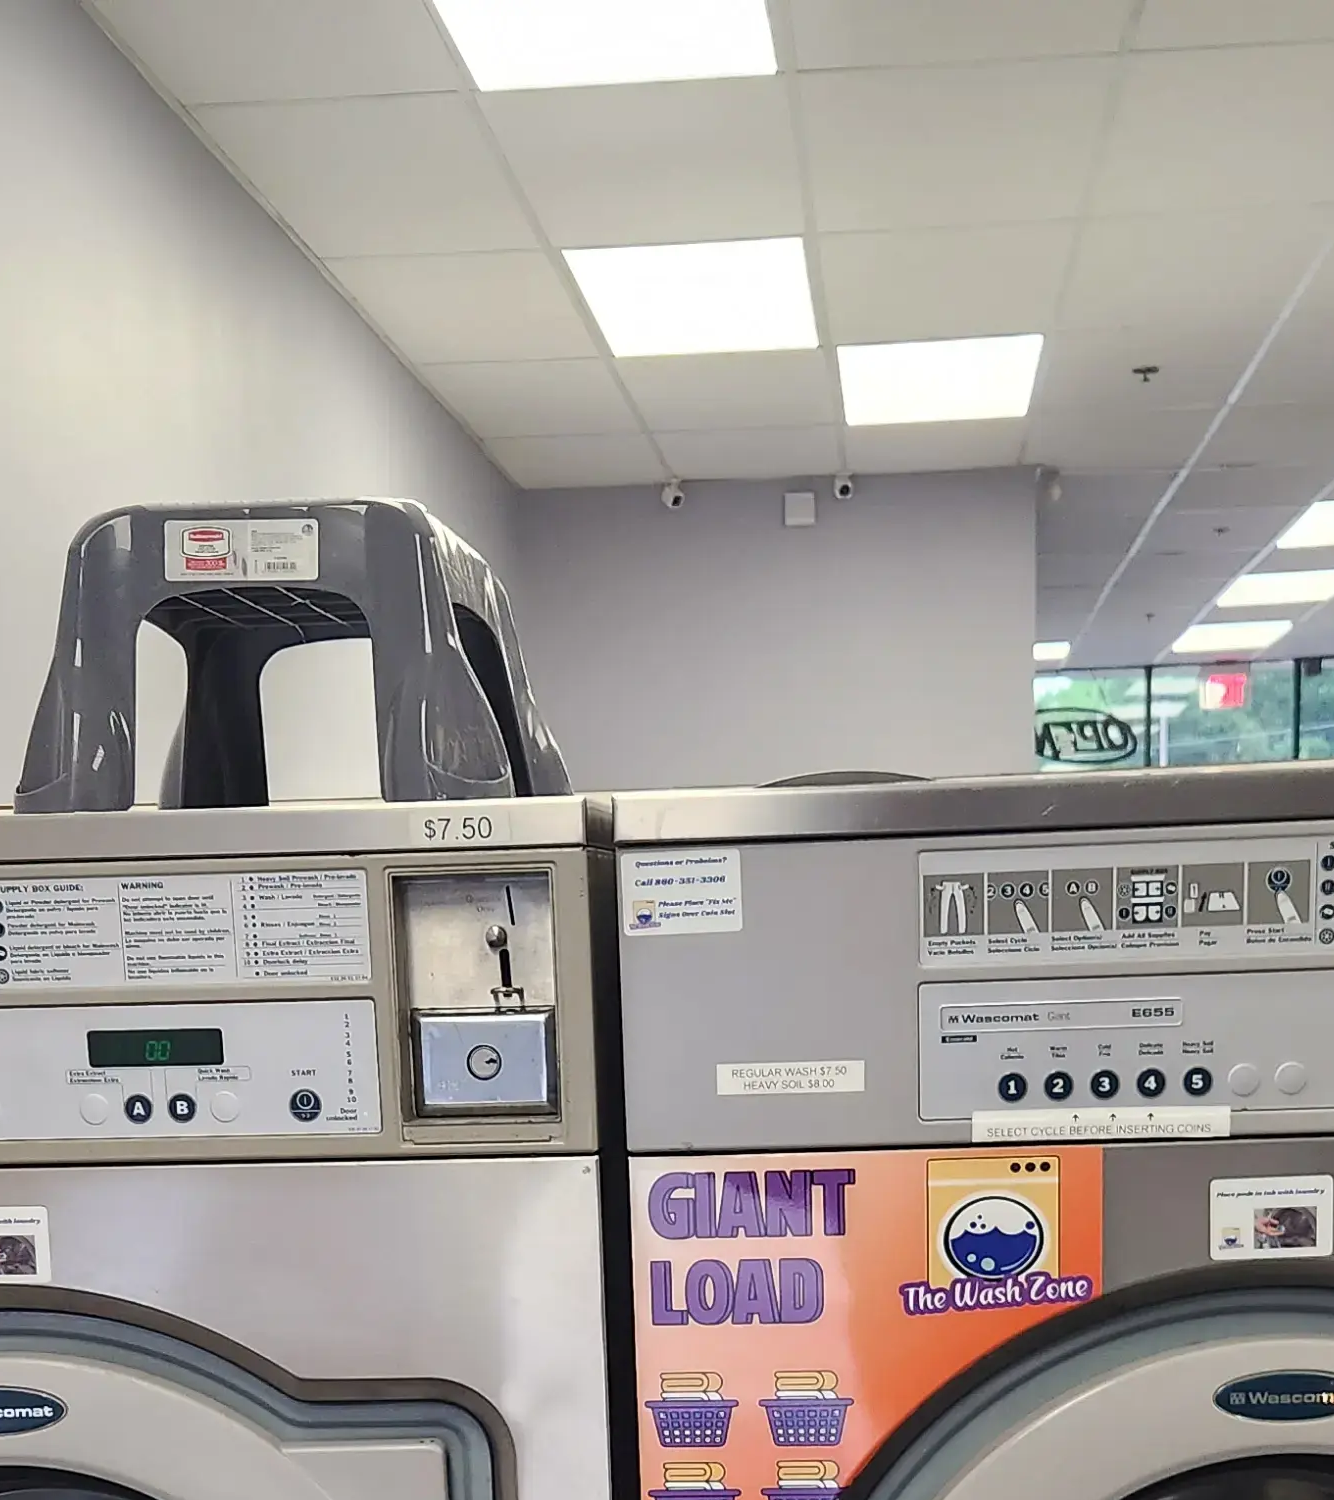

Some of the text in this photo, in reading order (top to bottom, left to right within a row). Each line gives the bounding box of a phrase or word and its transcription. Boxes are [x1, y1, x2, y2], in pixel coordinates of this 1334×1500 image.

[423, 816, 493, 840] $7.50
[635, 860, 673, 868] Questions
[32, 885, 51, 893] BOX
[121, 882, 164, 890] WARNING
[634, 878, 653, 886] Call
[1069, 882, 1096, 893] A B
[1004, 885, 1012, 896] 3
[1023, 885, 1031, 895] 4
[658, 911, 680, 919] Signs
[961, 1012, 1039, 1024] Wascomat
[1132, 1007, 1174, 1019] E655
[145, 1041, 171, 1061] 00
[732, 1068, 781, 1078] REGULAR
[784, 1067, 817, 1077] WASH
[744, 1080, 779, 1090] HEAVY
[782, 1079, 804, 1089] SOIL
[1008, 1080, 1017, 1095] 1
[1053, 1079, 1064, 1093] 2
[1099, 1077, 1110, 1091] 3
[1144, 1076, 1157, 1090] 4
[1191, 1074, 1203, 1089] 5
[133, 1101, 146, 1116] A
[176, 1101, 189, 1115] B
[987, 1123, 1211, 1137] SELECT CYCLE BEFORE INSERTING COINS
[647, 1168, 856, 1240] GIANT
[651, 1258, 824, 1327] LOAD
[906, 1274, 1088, 1312] The Wash Zone
